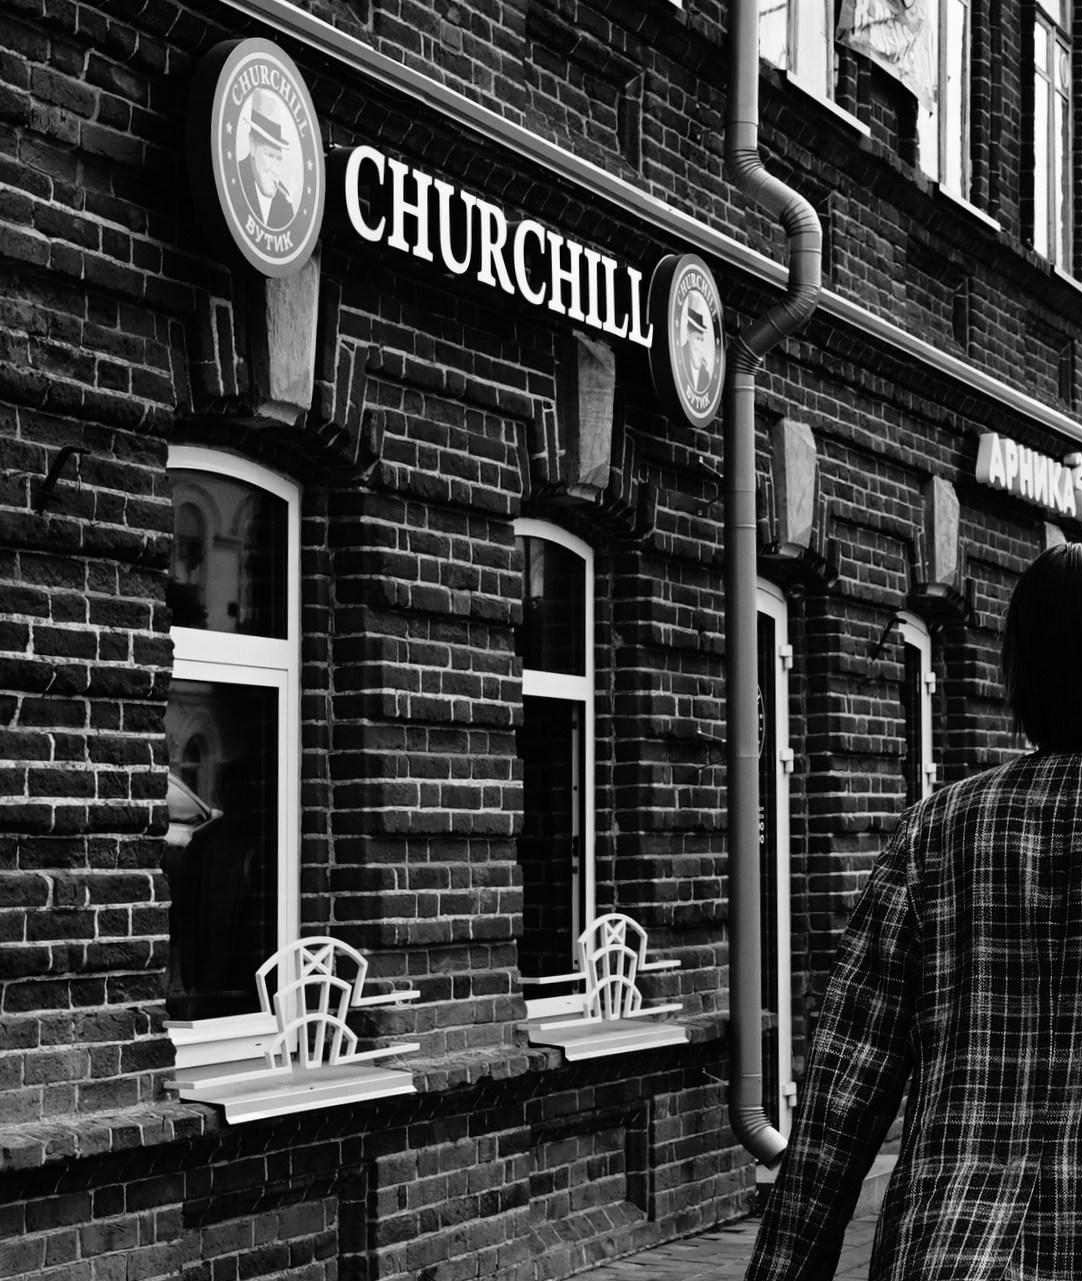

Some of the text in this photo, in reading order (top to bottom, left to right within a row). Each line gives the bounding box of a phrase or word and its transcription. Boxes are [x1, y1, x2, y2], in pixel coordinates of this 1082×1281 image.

[231, 64, 308, 138] CHURCHILL
[345, 145, 654, 348] CHURCHILL
[988, 432, 1077, 518] АРНИКА
